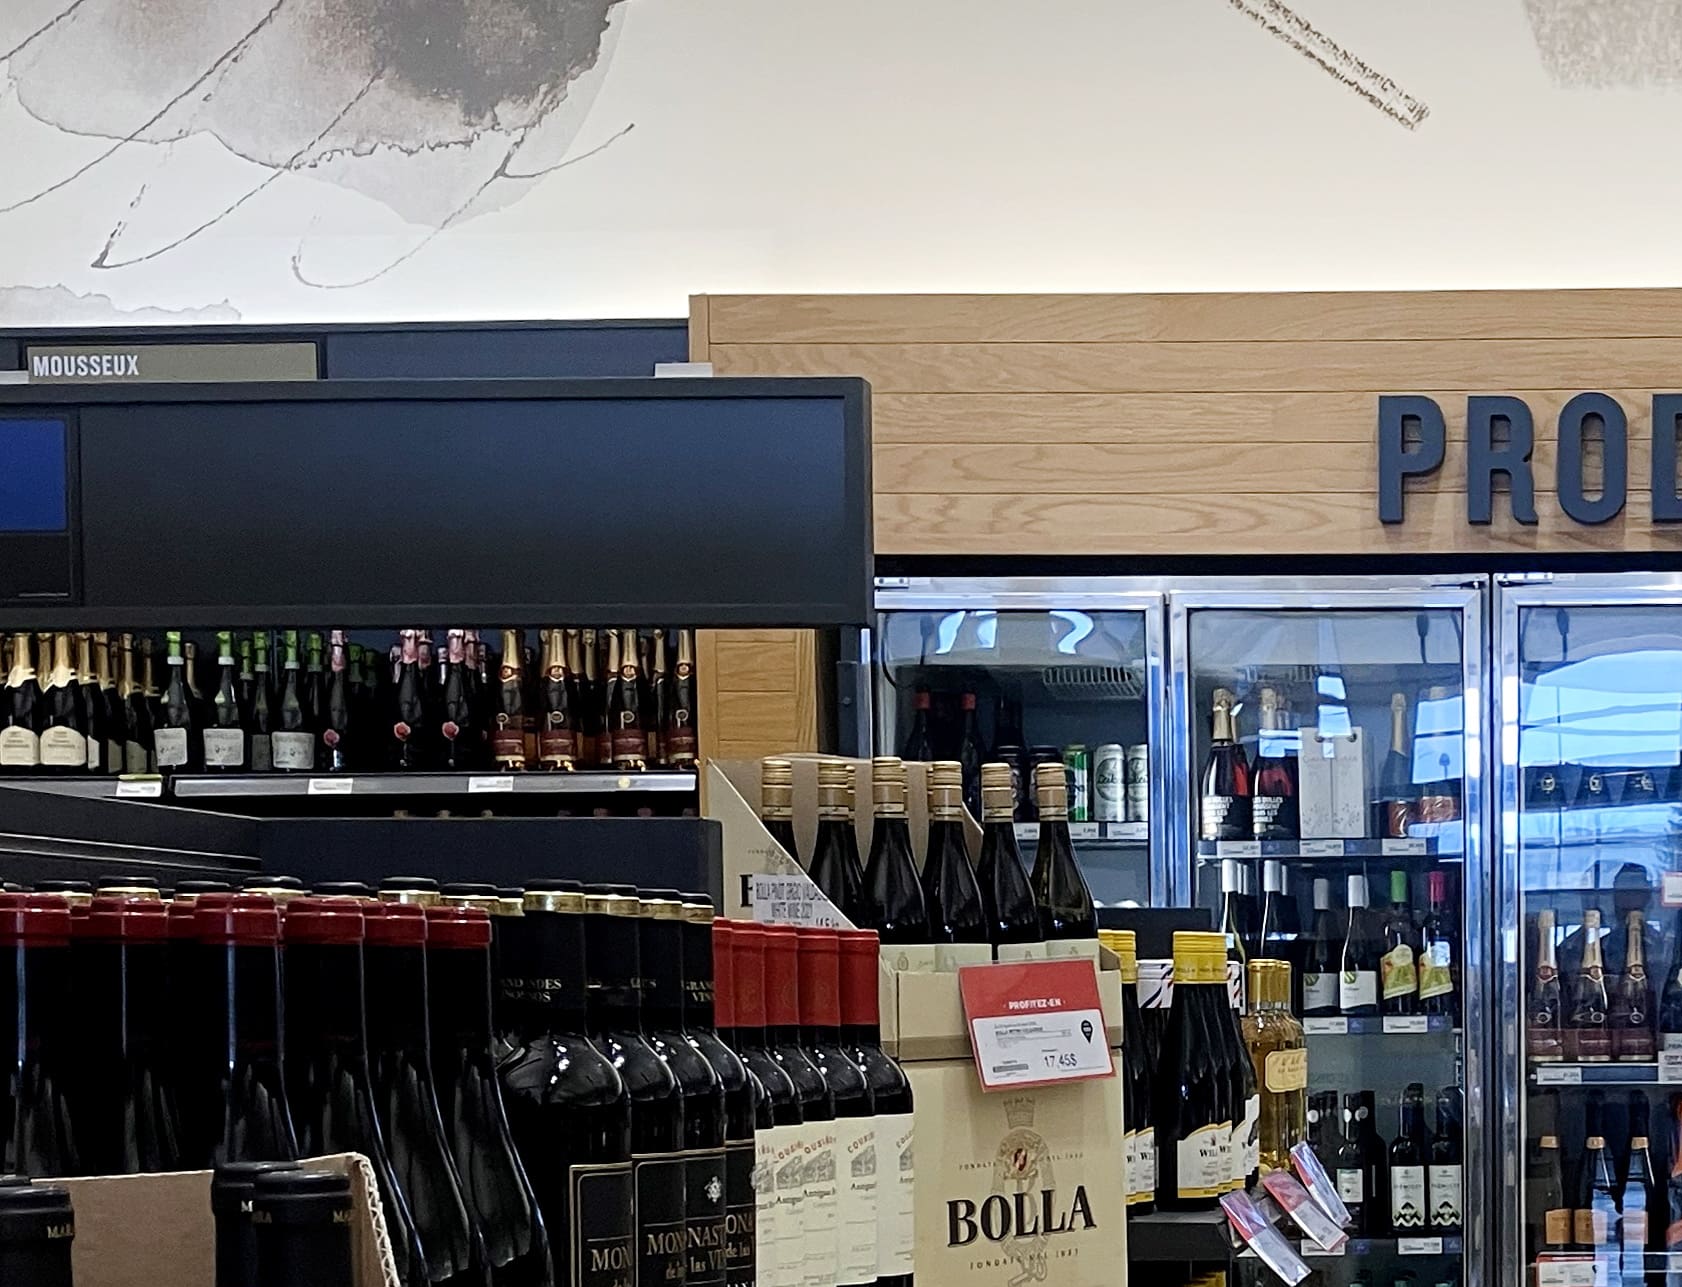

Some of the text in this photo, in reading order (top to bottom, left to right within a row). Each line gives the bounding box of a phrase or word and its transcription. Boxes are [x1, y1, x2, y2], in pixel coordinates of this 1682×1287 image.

[33, 355, 139, 377] MOUSSEUX
[1008, 998, 1061, 1010] PROFITEZ-EN
[1044, 1052, 1078, 1069] 17,45$
[946, 1184, 1098, 1248] BOLLA
